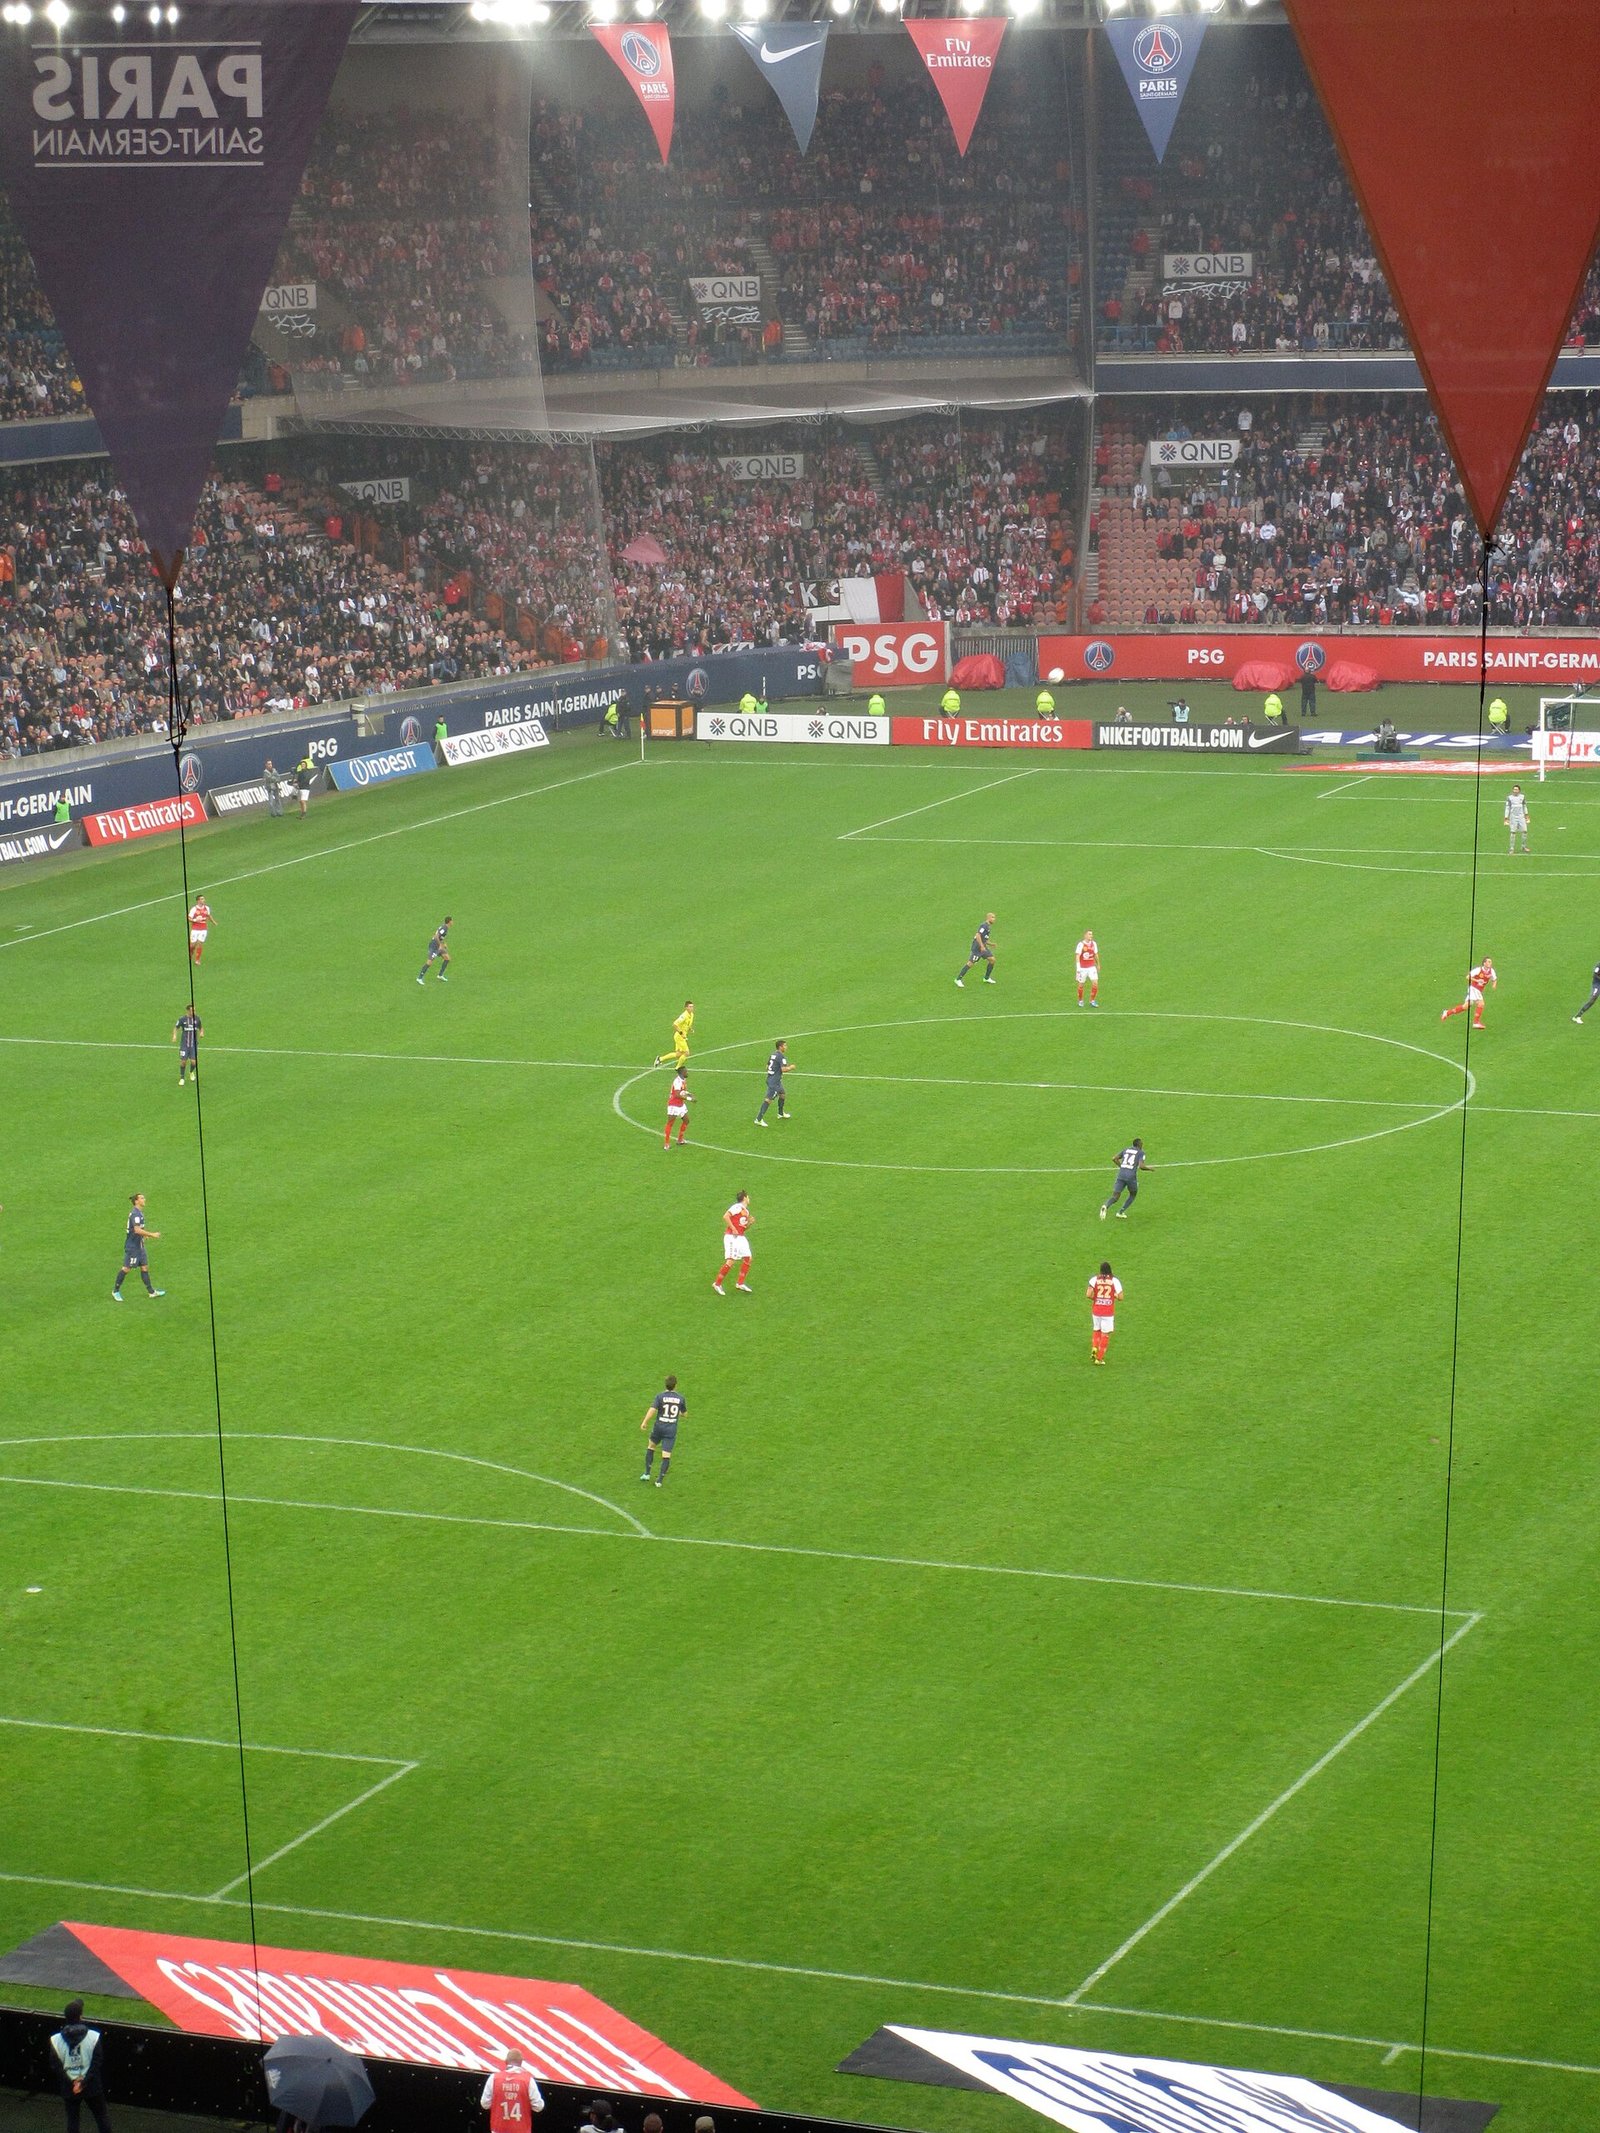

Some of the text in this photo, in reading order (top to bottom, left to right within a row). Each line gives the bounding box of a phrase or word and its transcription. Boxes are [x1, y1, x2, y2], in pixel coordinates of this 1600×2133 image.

[945, 38, 971, 54] Fly
[926, 53, 992, 68] Emirates
[640, 83, 669, 93] PARIS
[1139, 80, 1178, 92] PARIS
[1193, 255, 1245, 275] QNB
[266, 287, 309, 308] QNB
[711, 280, 759, 299] QNB
[1180, 442, 1233, 461] QNB
[746, 457, 797, 477] QNB
[362, 481, 403, 502] QNB
[843, 633, 939, 674] PSG
[1187, 649, 1225, 665] PSG
[1423, 652, 1600, 669] PARIS SAINT-GERM
[485, 689, 622, 728] PARIS SAINT-GERMAIN
[730, 718, 878, 739] QNB QNB
[922, 719, 1064, 745] Fly Emirates
[1099, 726, 1243, 748] NIKEFOOTBALL.COM
[308, 737, 338, 759] PSG
[458, 724, 546, 757] QNB QNB
[96, 801, 195, 840] Fly Emirates
[0, 834, 49, 861] BALL.COM
[1122, 1153, 1136, 1166] 14
[1096, 1285, 1112, 1299] 22
[662, 1404, 679, 1418] 19
[500, 2101, 522, 2122] 14
